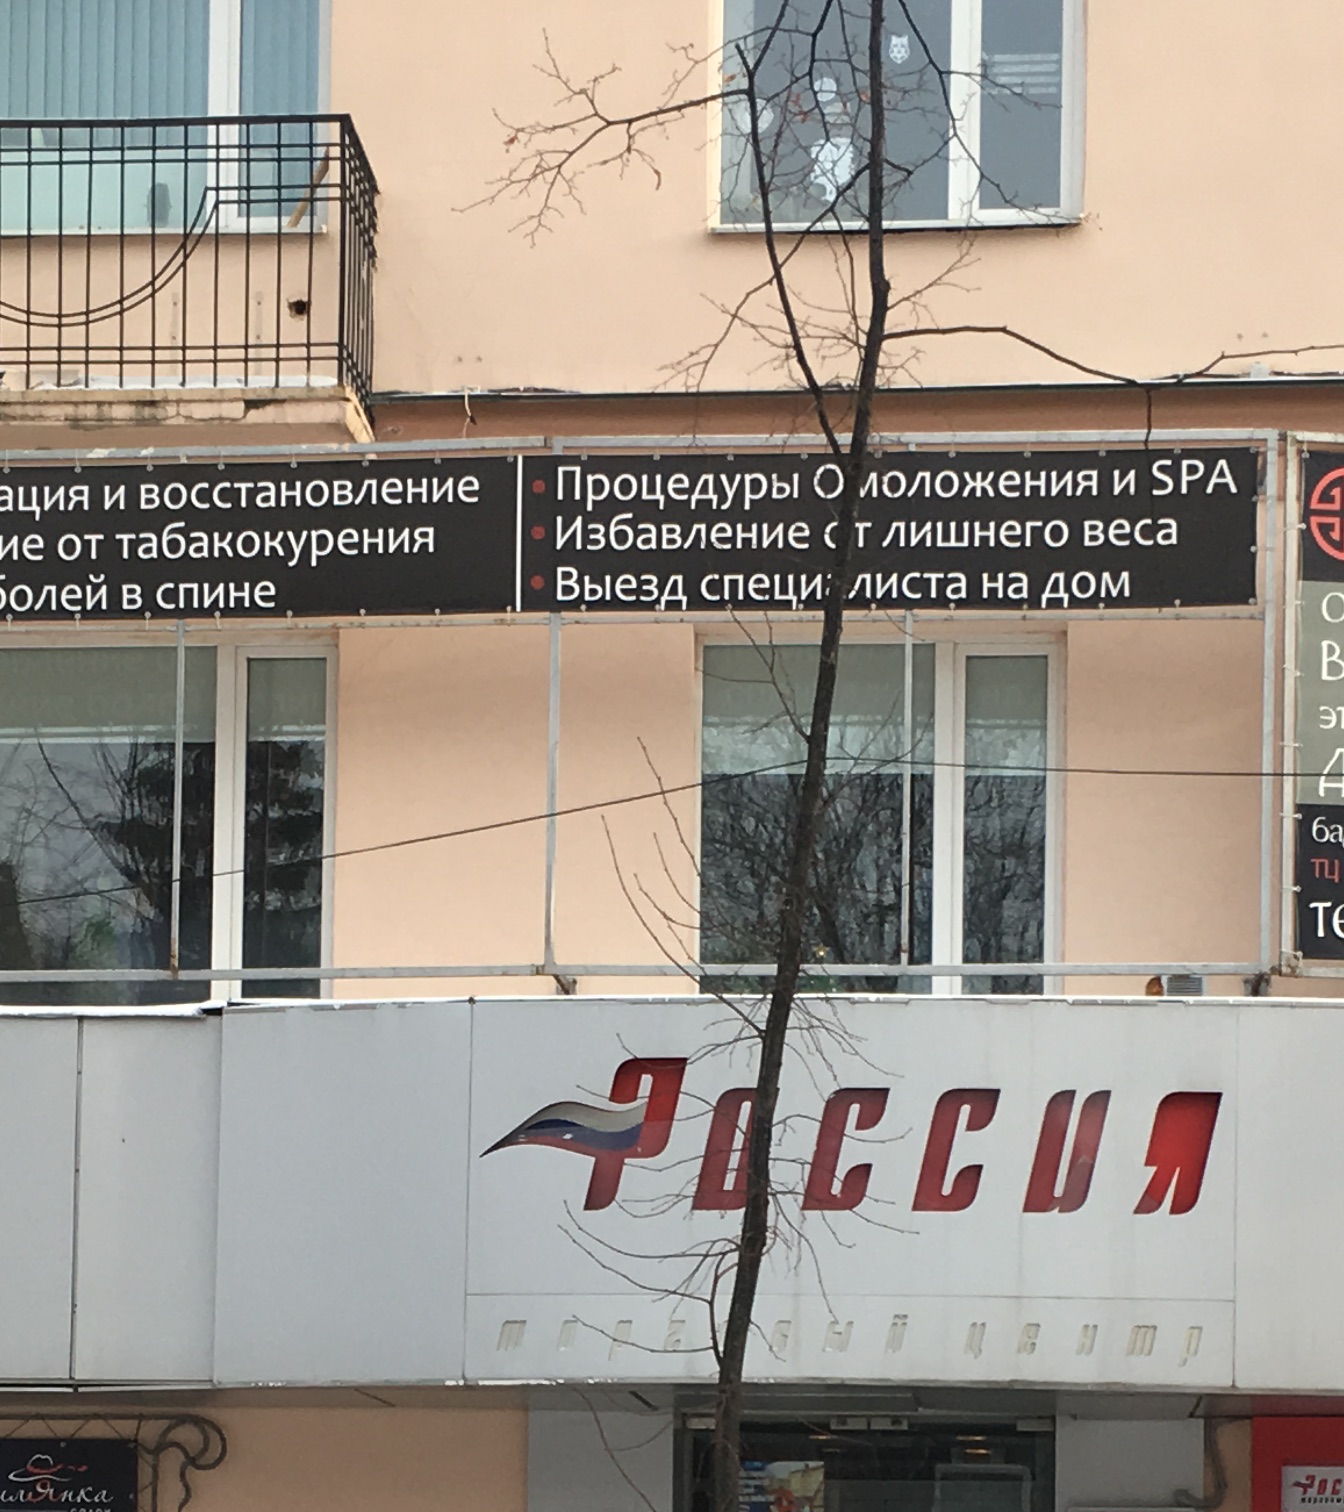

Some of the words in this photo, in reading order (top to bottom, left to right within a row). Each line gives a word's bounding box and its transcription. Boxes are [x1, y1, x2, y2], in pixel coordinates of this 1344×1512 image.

[104, 484, 126, 510] и
[140, 472, 479, 509] восстановление
[556, 466, 800, 510] Процедуры
[1113, 469, 1137, 497] и
[1152, 460, 1238, 497] SPA
[58, 532, 101, 560] от
[116, 524, 436, 566] табакокурения
[555, 514, 810, 550] Избавление
[882, 518, 1070, 549] лишнего
[1083, 517, 1178, 546] веса
[123, 582, 143, 609] в
[156, 578, 277, 608] спине
[556, 567, 687, 611] Выезд
[700, 567, 967, 608] специлиста
[982, 571, 1028, 599] на
[1042, 568, 1130, 609] дом
[1311, 858, 1342, 885] ТЦ
[496, 1314, 909, 1361] торгвый
[966, 1321, 1204, 1367] центр
